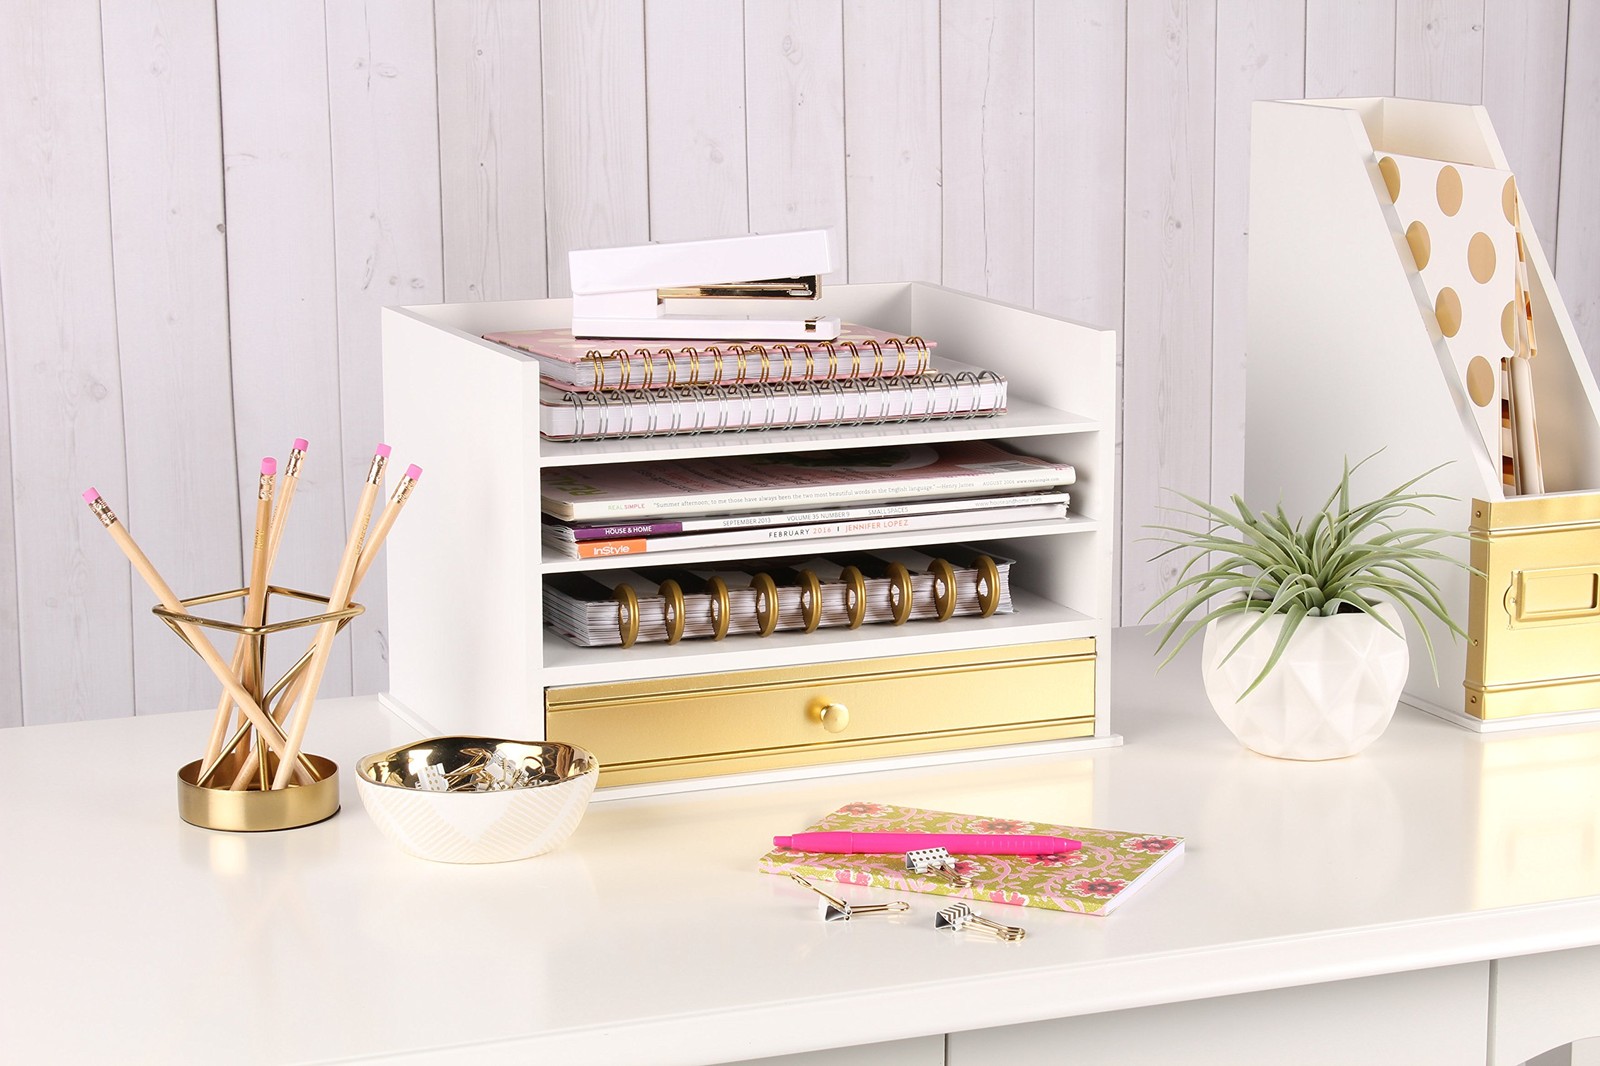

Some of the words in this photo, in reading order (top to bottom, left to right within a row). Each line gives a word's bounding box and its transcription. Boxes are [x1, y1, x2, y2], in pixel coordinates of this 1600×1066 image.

[888, 506, 909, 514] SPACES
[722, 518, 757, 526] SEPTEMBER
[605, 527, 626, 535] HOUSE
[633, 525, 652, 533] HOME
[768, 529, 810, 538] FEBRUARY
[845, 522, 881, 532] JENNIFER
[883, 520, 909, 529] LOPEZ
[593, 545, 630, 556] InStyle
